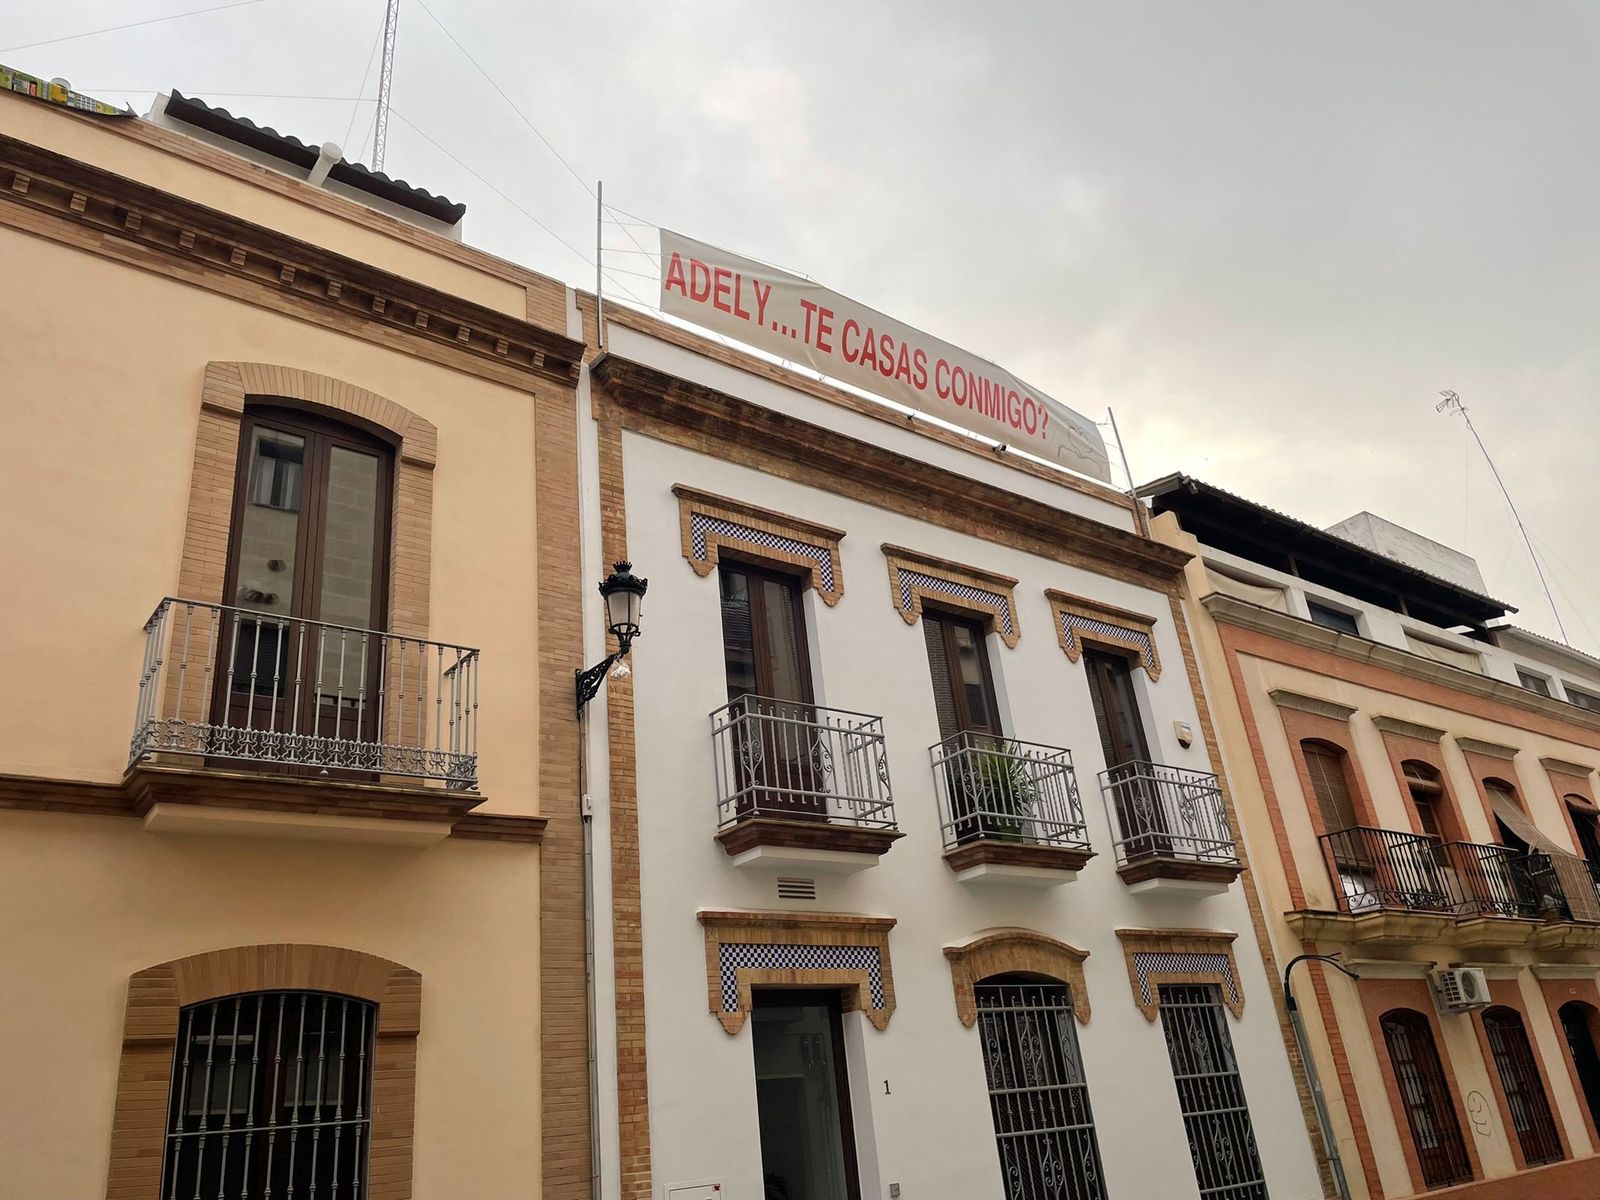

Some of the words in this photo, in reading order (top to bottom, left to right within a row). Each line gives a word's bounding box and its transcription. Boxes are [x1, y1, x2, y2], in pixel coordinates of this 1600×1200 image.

[841, 319, 928, 391] CASAS
[935, 358, 1049, 439] CONMIGO?
[883, 1079, 892, 1095] 1
